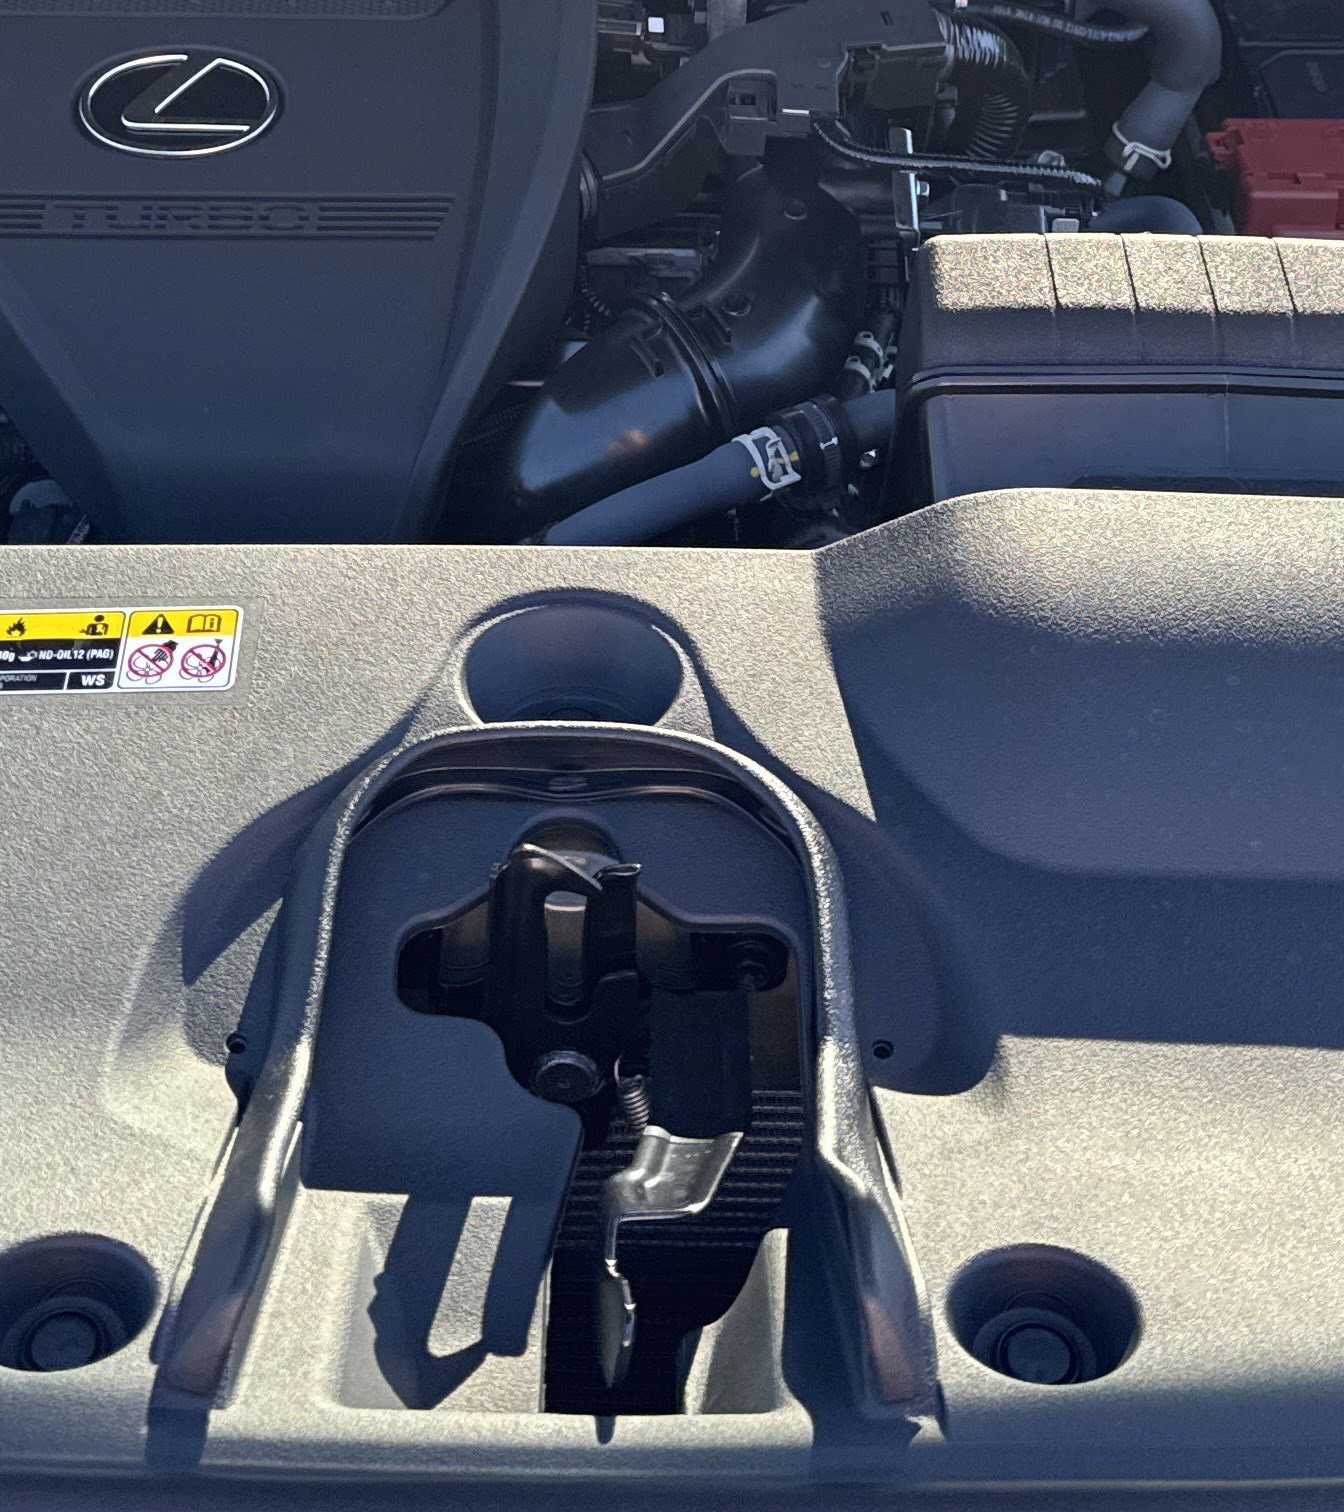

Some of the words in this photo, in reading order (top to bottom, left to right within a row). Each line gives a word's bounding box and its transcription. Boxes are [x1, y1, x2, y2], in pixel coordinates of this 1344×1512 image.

[56, 205, 310, 230] TURBO
[85, 648, 114, 661] (PAG)
[81, 674, 106, 686] WS
